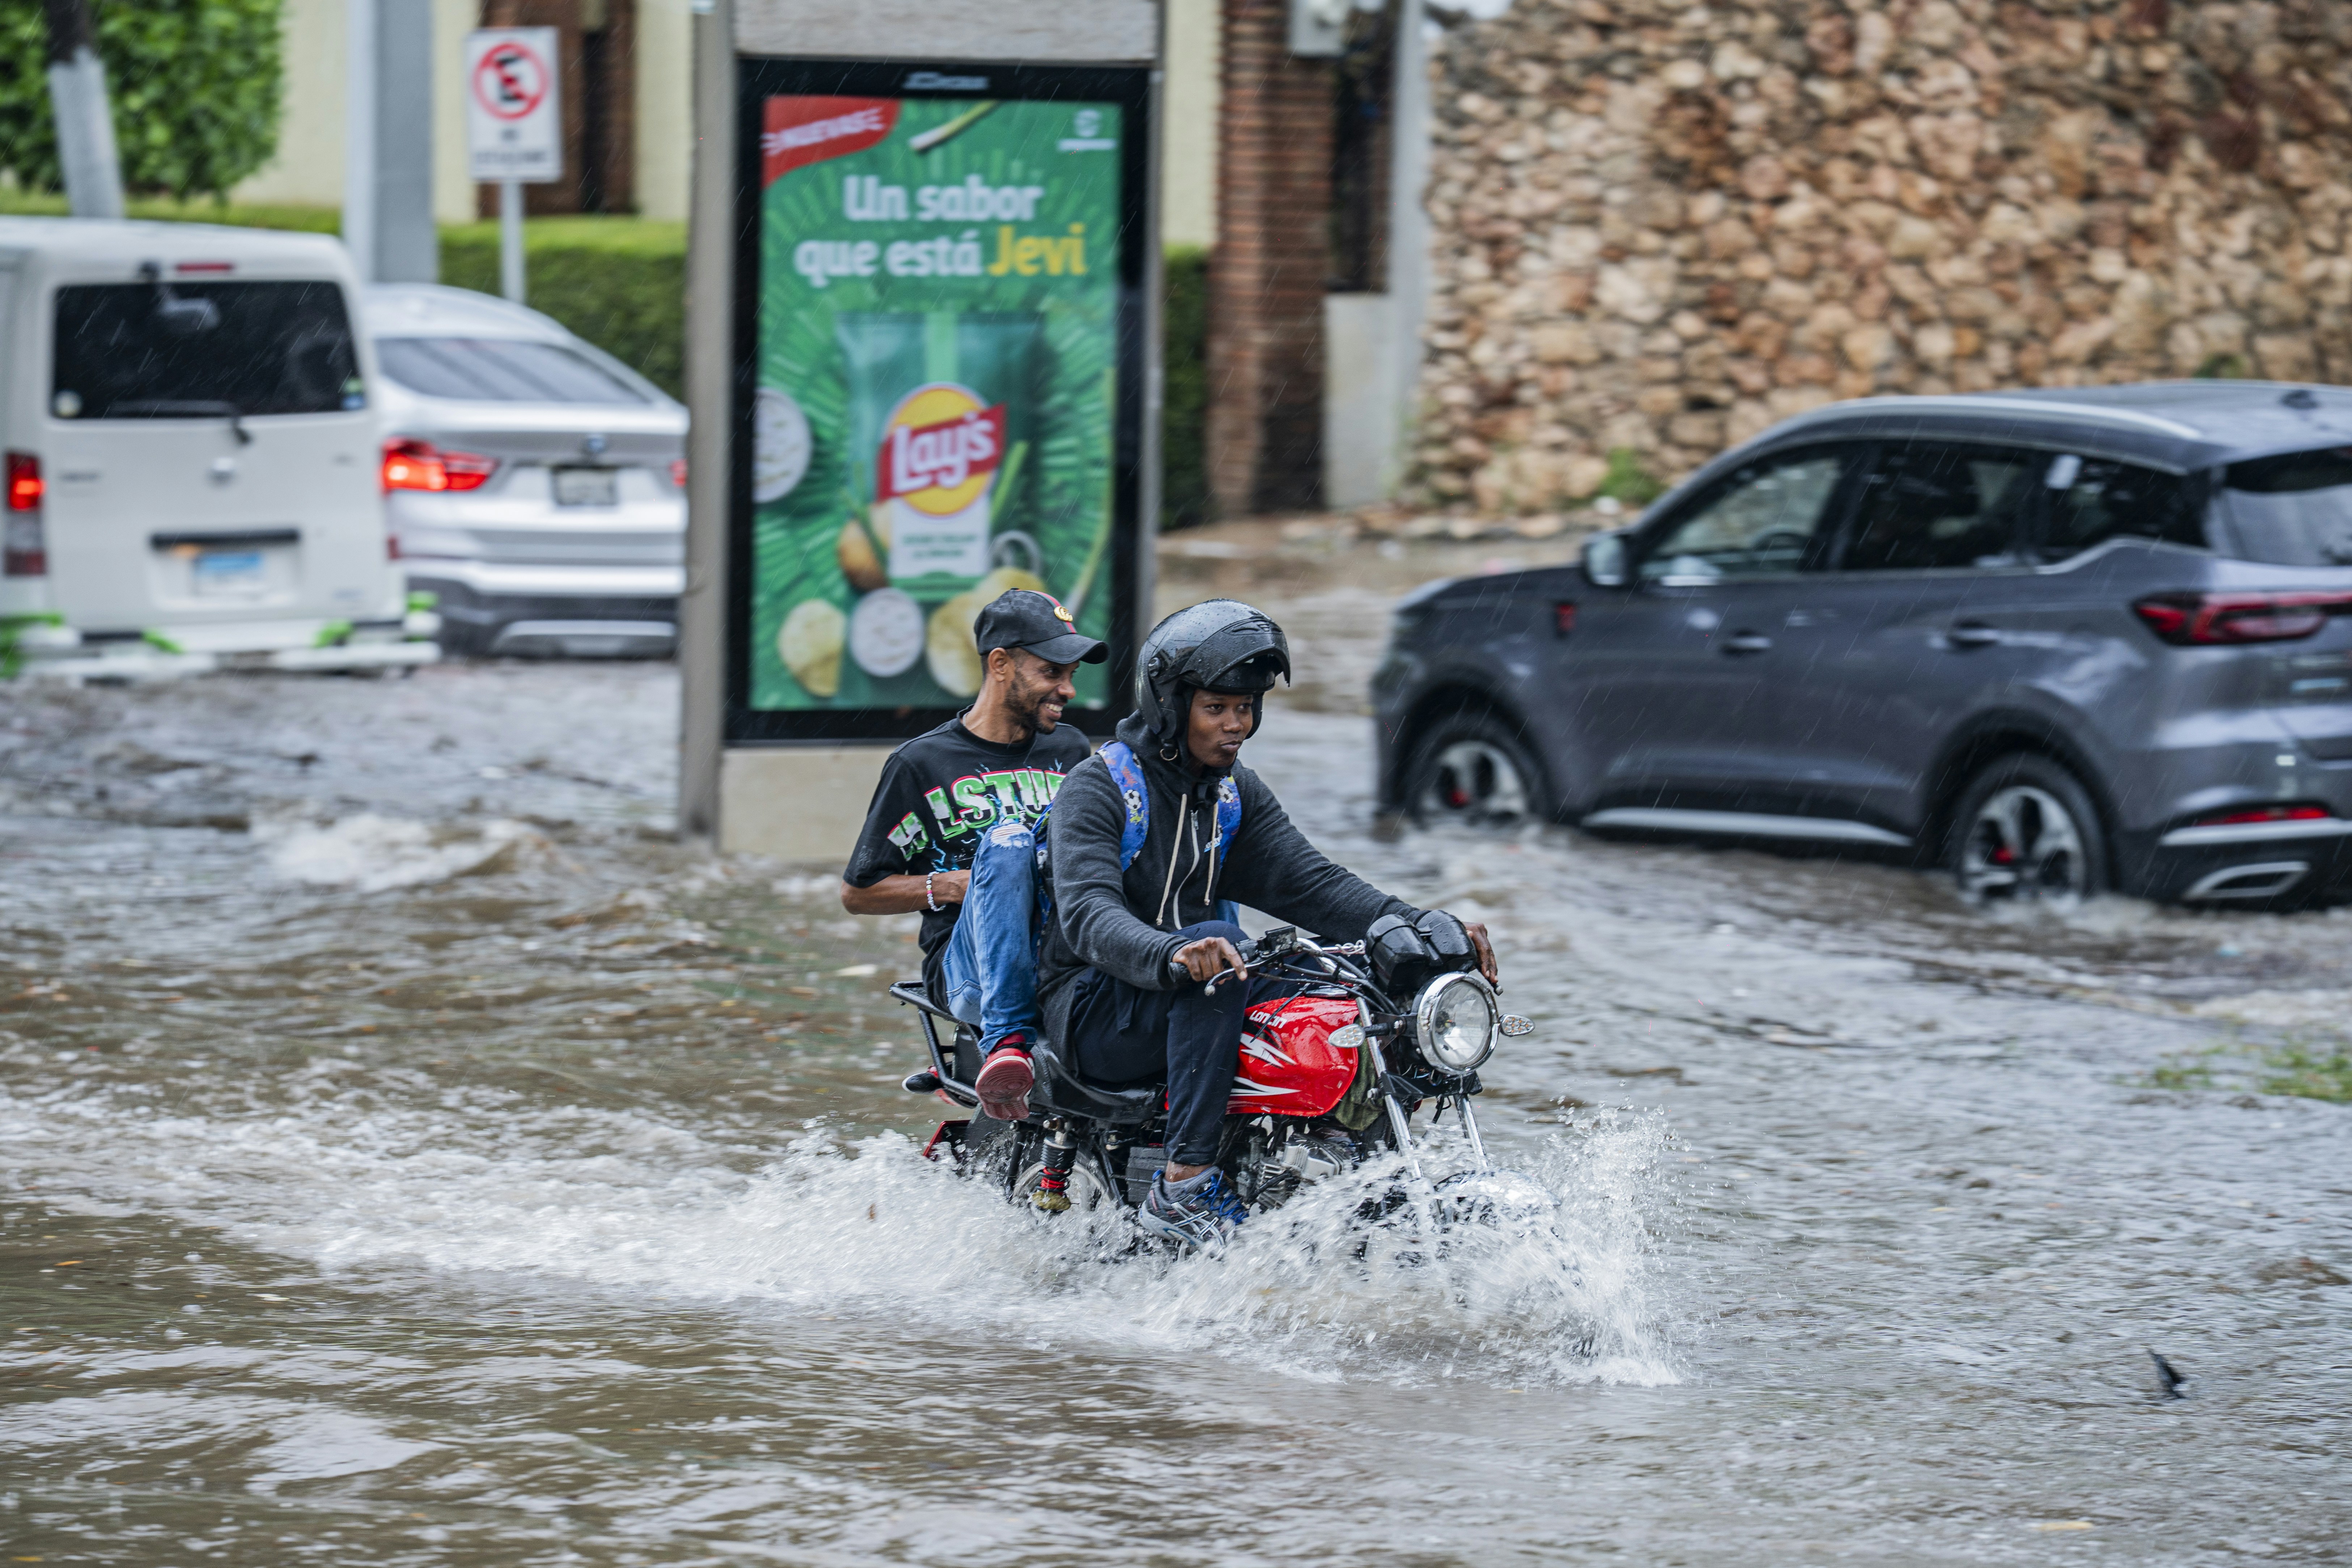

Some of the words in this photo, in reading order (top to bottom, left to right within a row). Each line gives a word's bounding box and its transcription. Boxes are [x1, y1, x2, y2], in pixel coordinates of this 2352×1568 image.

[843, 174, 910, 221] Un
[916, 173, 1044, 221] sabor
[794, 240, 881, 288] que
[885, 228, 984, 277] está
[987, 222, 1090, 277] Jevi
[892, 411, 996, 493] Lay's
